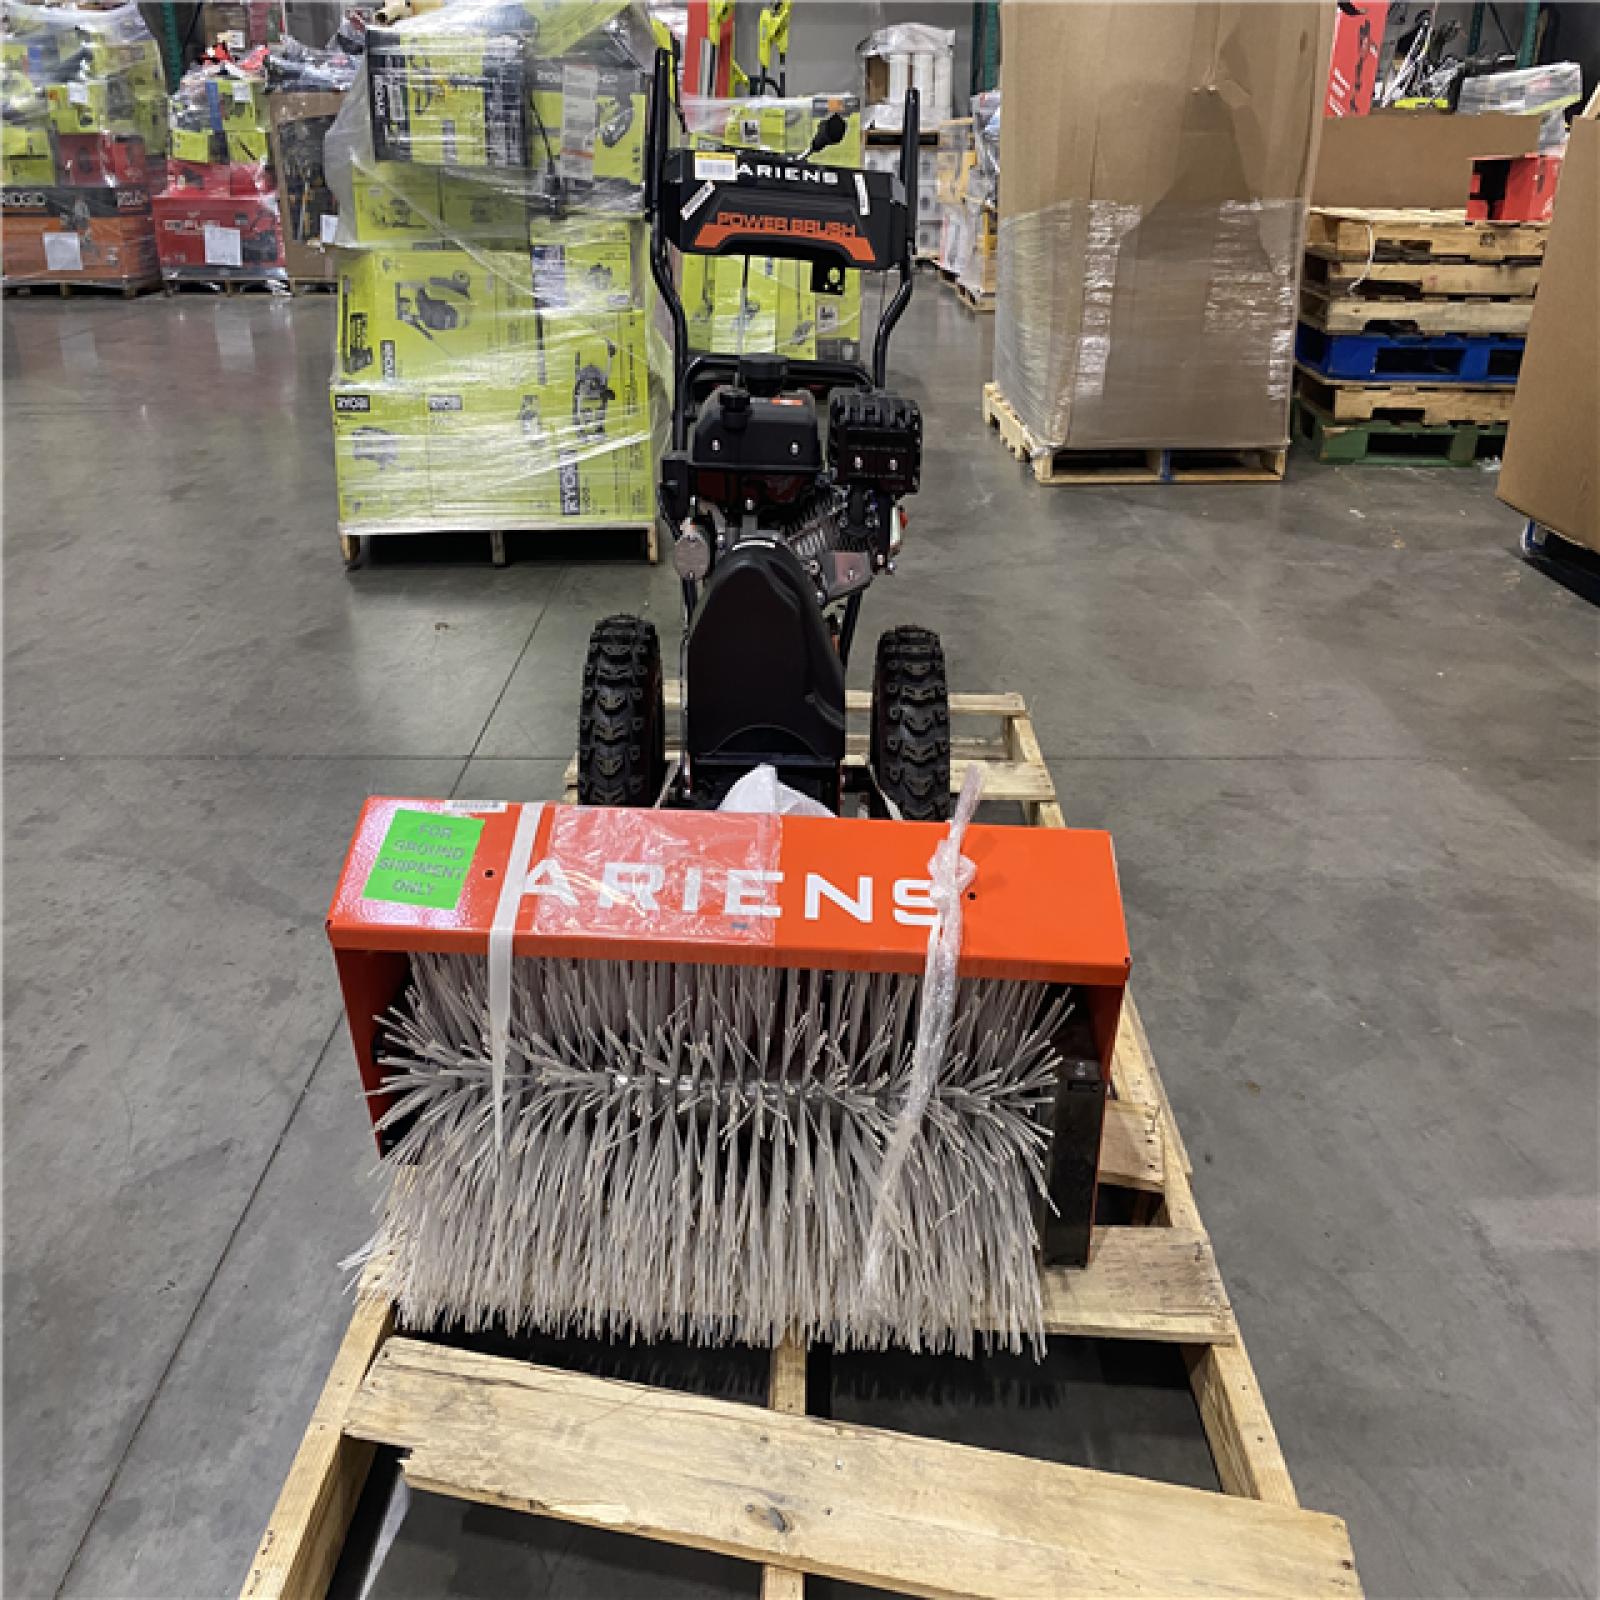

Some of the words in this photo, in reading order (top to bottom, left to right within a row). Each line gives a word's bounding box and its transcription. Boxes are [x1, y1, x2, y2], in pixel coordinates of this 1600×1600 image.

[738, 163, 839, 184] ARIENS
[717, 211, 788, 230] POWER
[792, 218, 855, 238] BRUSH
[419, 823, 454, 839] FOR
[393, 839, 465, 861] GROUND
[379, 857, 465, 881] SHIPMENT
[391, 879, 435, 896] ONLY
[518, 858, 941, 926] ARIENS
